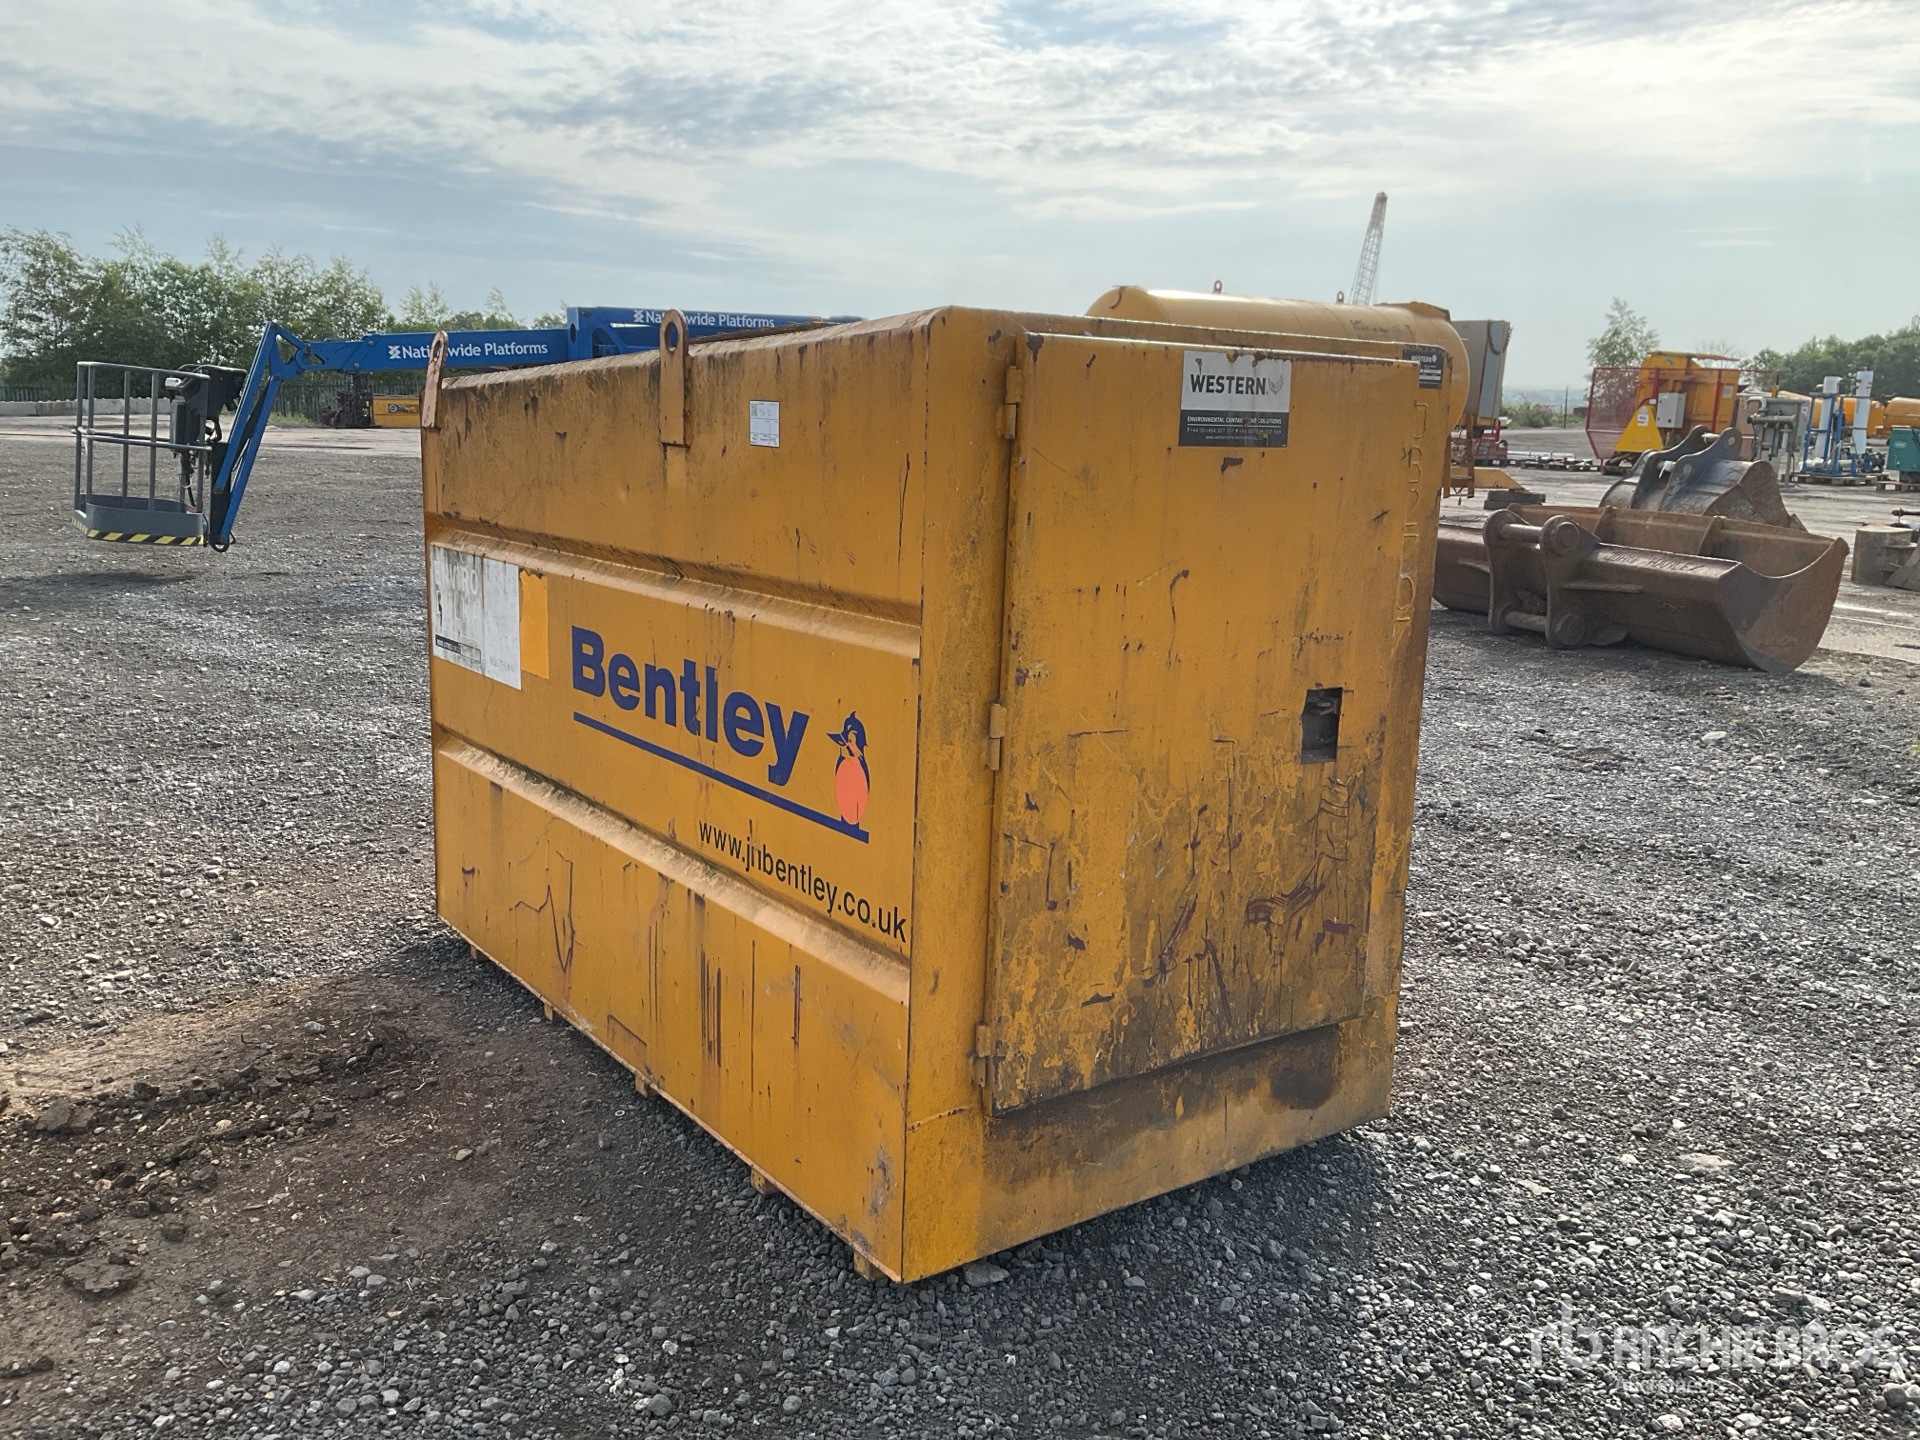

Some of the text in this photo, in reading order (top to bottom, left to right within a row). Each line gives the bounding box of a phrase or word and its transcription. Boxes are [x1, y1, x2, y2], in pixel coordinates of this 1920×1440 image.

[718, 313, 775, 328] Platforms
[402, 341, 548, 359] Natiwide Platforms
[1190, 374, 1266, 395] WESTERN
[571, 625, 810, 787] Bentley
